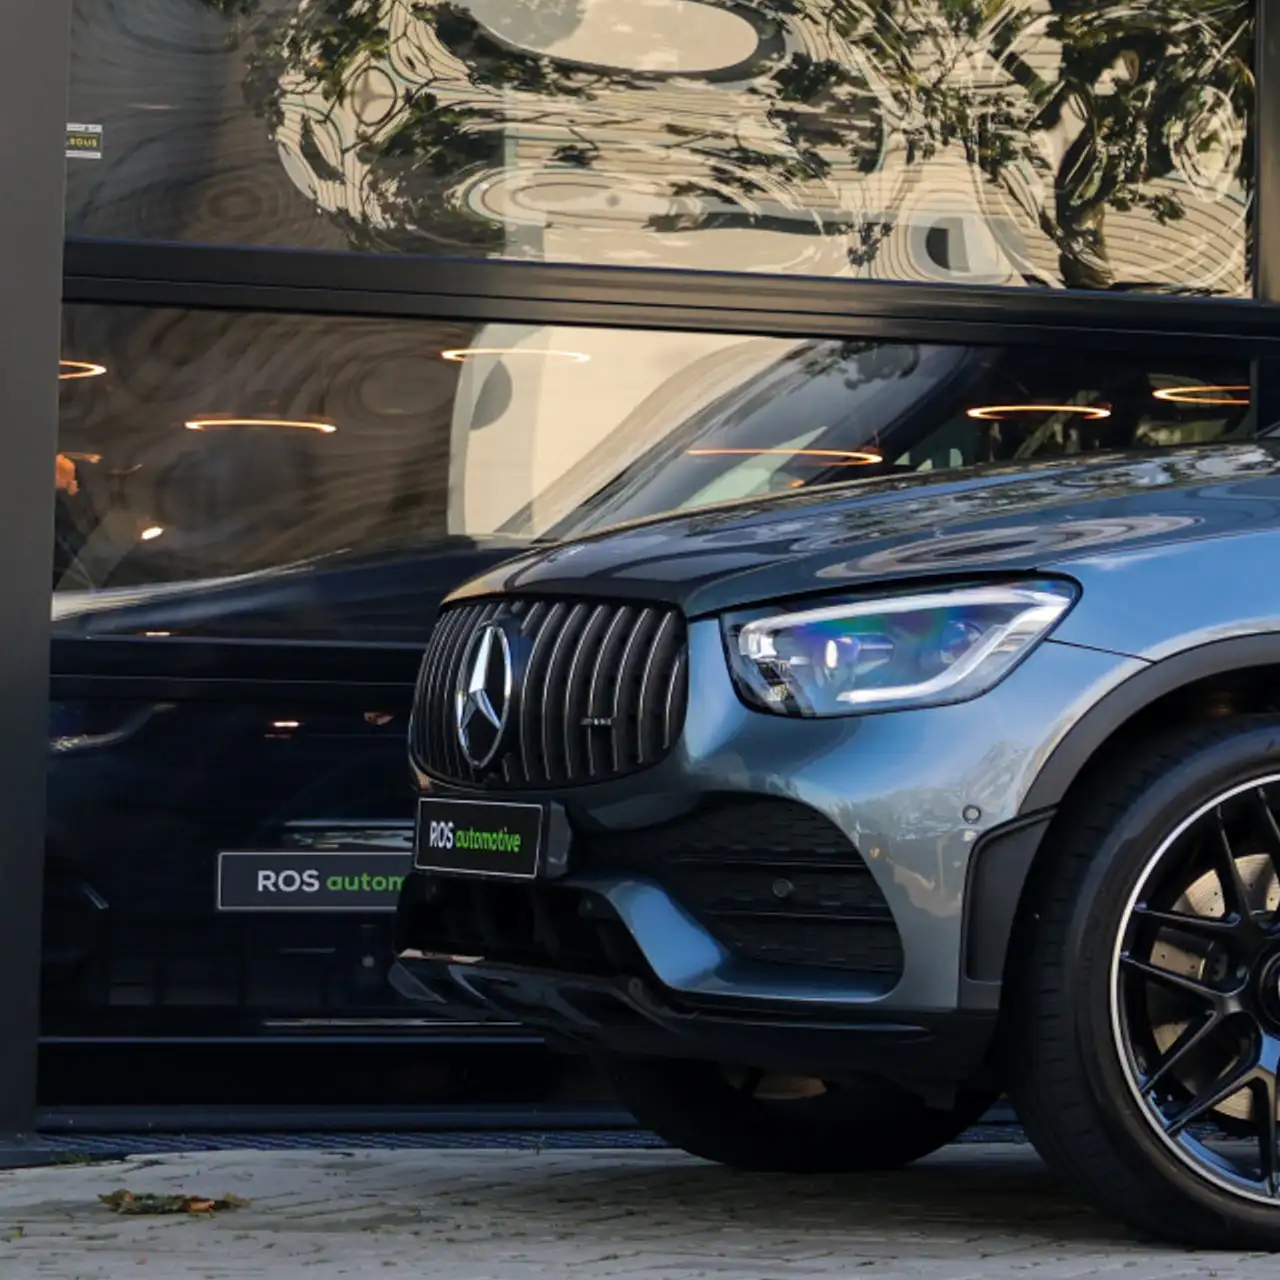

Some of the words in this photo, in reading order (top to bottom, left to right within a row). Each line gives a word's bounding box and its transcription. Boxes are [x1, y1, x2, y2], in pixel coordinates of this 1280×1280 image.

[429, 820, 454, 849] ROS
[455, 826, 521, 853] automotive
[257, 870, 320, 892] ROS
